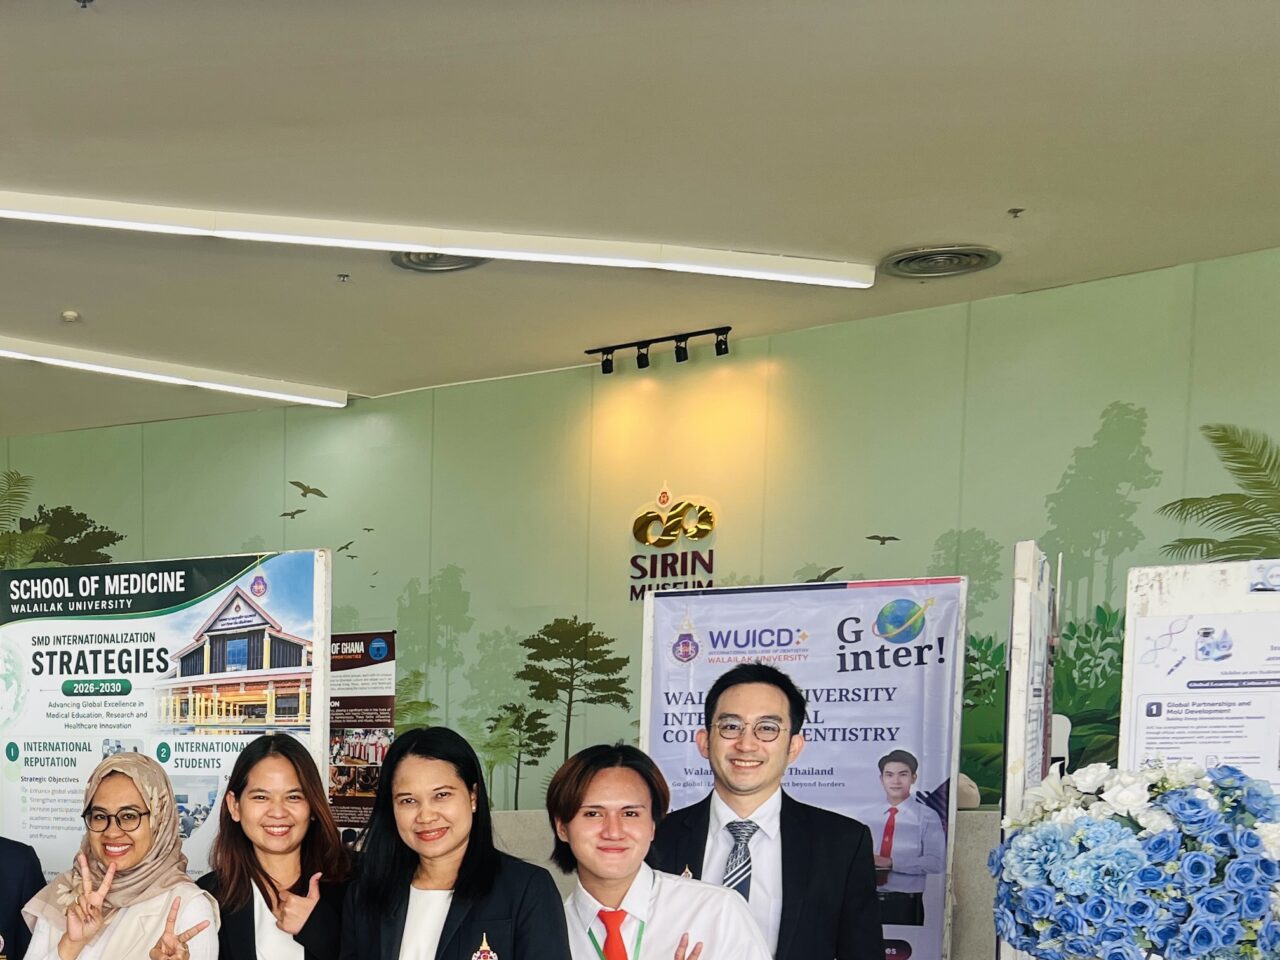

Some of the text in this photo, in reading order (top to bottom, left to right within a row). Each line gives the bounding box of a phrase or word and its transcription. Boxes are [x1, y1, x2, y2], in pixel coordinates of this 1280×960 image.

[630, 549, 713, 579] SIRIN
[9, 571, 186, 600] SCHOOL OF MEDICINE
[11, 599, 133, 613] WALAILAK UNIVERSITY
[31, 632, 156, 646] SMD INTERNATIONALIZATION
[708, 628, 793, 649] WUICD
[331, 641, 364, 654] OF GHANA
[31, 647, 169, 676] STRATEGIES
[708, 654, 809, 664] WALAILAK UNIVERSITY
[48, 701, 80, 709] Advancing
[1150, 705, 1157, 714] 1
[23, 741, 92, 752] INTERNATIONAL
[160, 741, 250, 757] 2 INTERNATIONA
[24, 757, 77, 767] REPUTATION
[174, 758, 221, 769] STUDENTS
[789, 767, 834, 776] Thailand
[20, 776, 79, 784] Strategic Objectives
[791, 780, 817, 789] beyond
